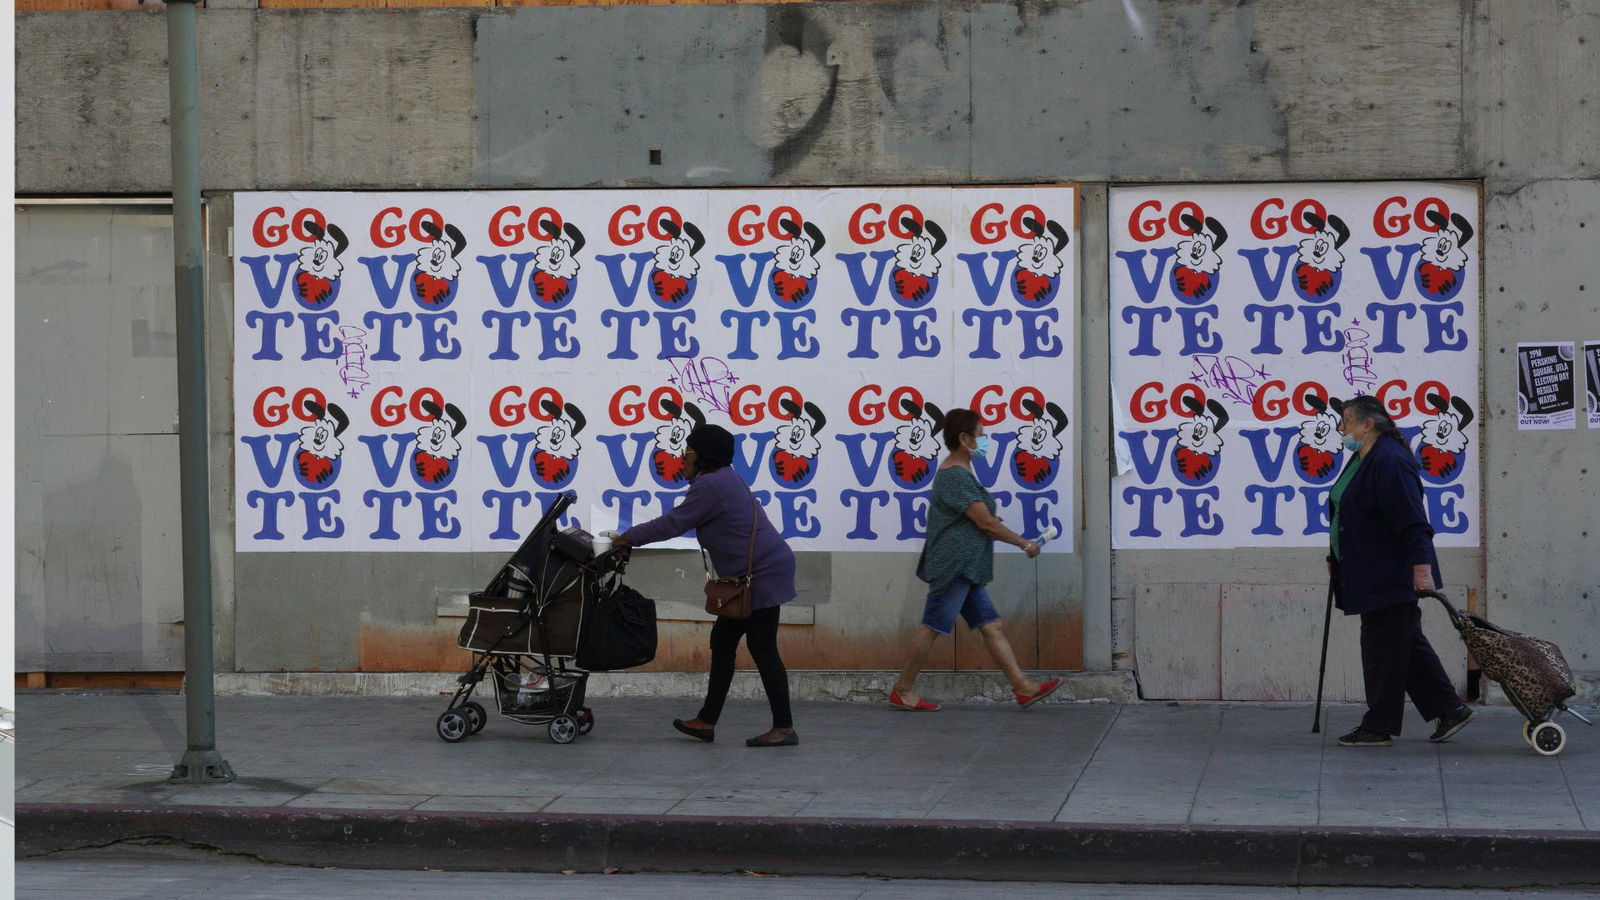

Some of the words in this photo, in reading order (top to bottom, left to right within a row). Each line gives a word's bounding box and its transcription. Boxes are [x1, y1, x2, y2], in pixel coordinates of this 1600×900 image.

[253, 207, 326, 247] GO
[370, 208, 444, 248] GO
[489, 206, 562, 247] GO
[608, 205, 682, 246] GO
[728, 205, 802, 246] GO
[849, 203, 924, 244] GO
[971, 203, 1046, 244] GO
[1129, 200, 1204, 242] GO
[1251, 198, 1326, 240] GO
[1374, 197, 1449, 238] GO
[1529, 349, 1542, 358] 2PM
[1531, 355, 1558, 368] PERSHING
[1533, 365, 1556, 377] SQUARE,
[1556, 362, 1569, 372] DTLA
[1535, 374, 1559, 386] ELECTION
[1558, 371, 1570, 382] DAY
[1536, 384, 1559, 396] RESULTS
[254, 387, 328, 427] GO
[371, 386, 444, 427] GO
[490, 386, 563, 427] GO
[609, 385, 683, 426] GO
[730, 385, 803, 426] GO
[849, 385, 923, 425] GO
[970, 385, 1045, 426] GO
[1130, 382, 1206, 422] GO
[1252, 381, 1328, 420] GO
[1376, 380, 1450, 420] GO
[1538, 393, 1558, 405] WATCH
